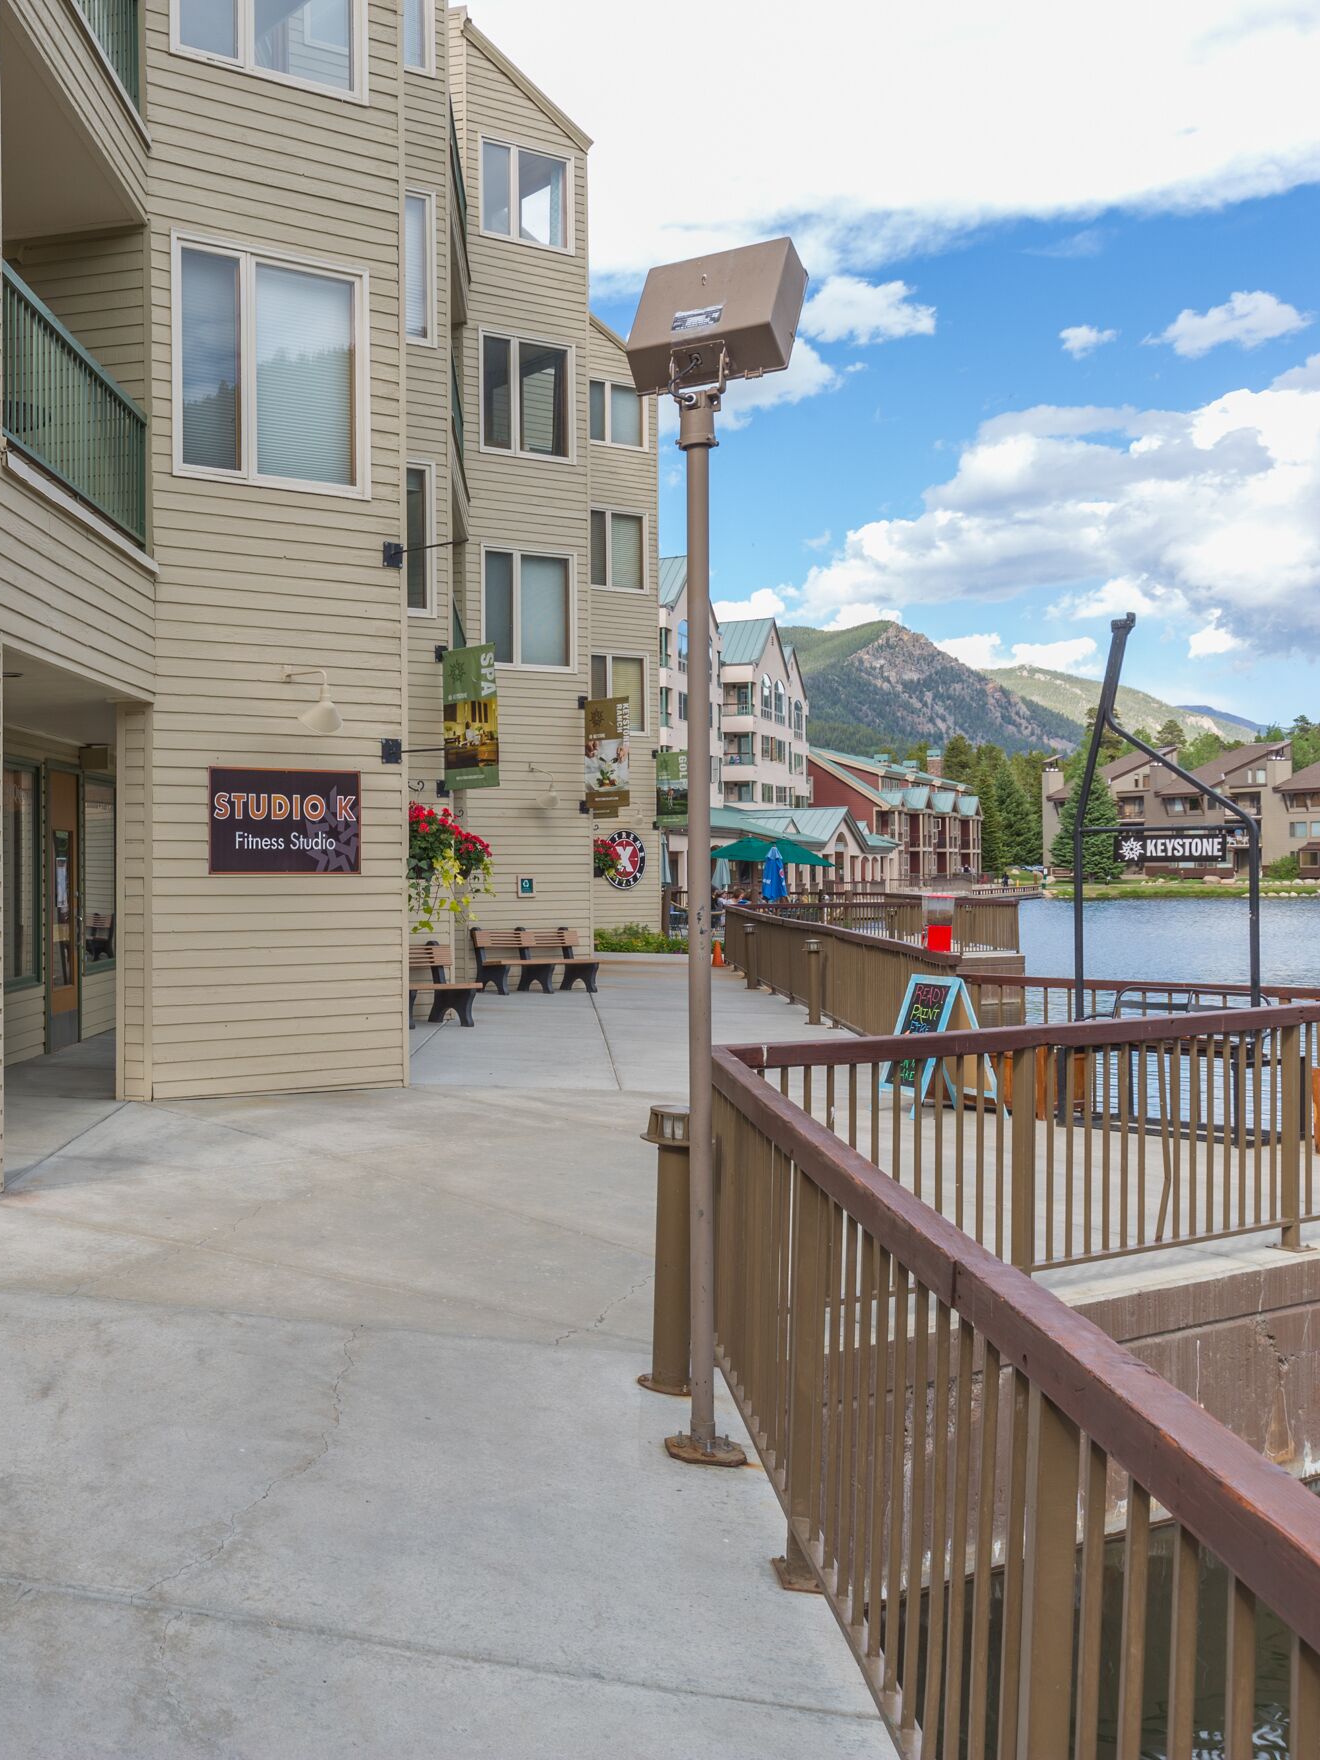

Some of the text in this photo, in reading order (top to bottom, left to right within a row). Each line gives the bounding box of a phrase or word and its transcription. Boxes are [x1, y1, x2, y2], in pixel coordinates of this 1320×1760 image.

[480, 652, 496, 697] SPA
[213, 792, 356, 821] STUDIO K
[235, 831, 336, 850] Fitness Studio
[1146, 838, 1223, 857] KEYSTONE
[615, 846, 634, 872] X
[909, 1004, 940, 1023] PAINT
